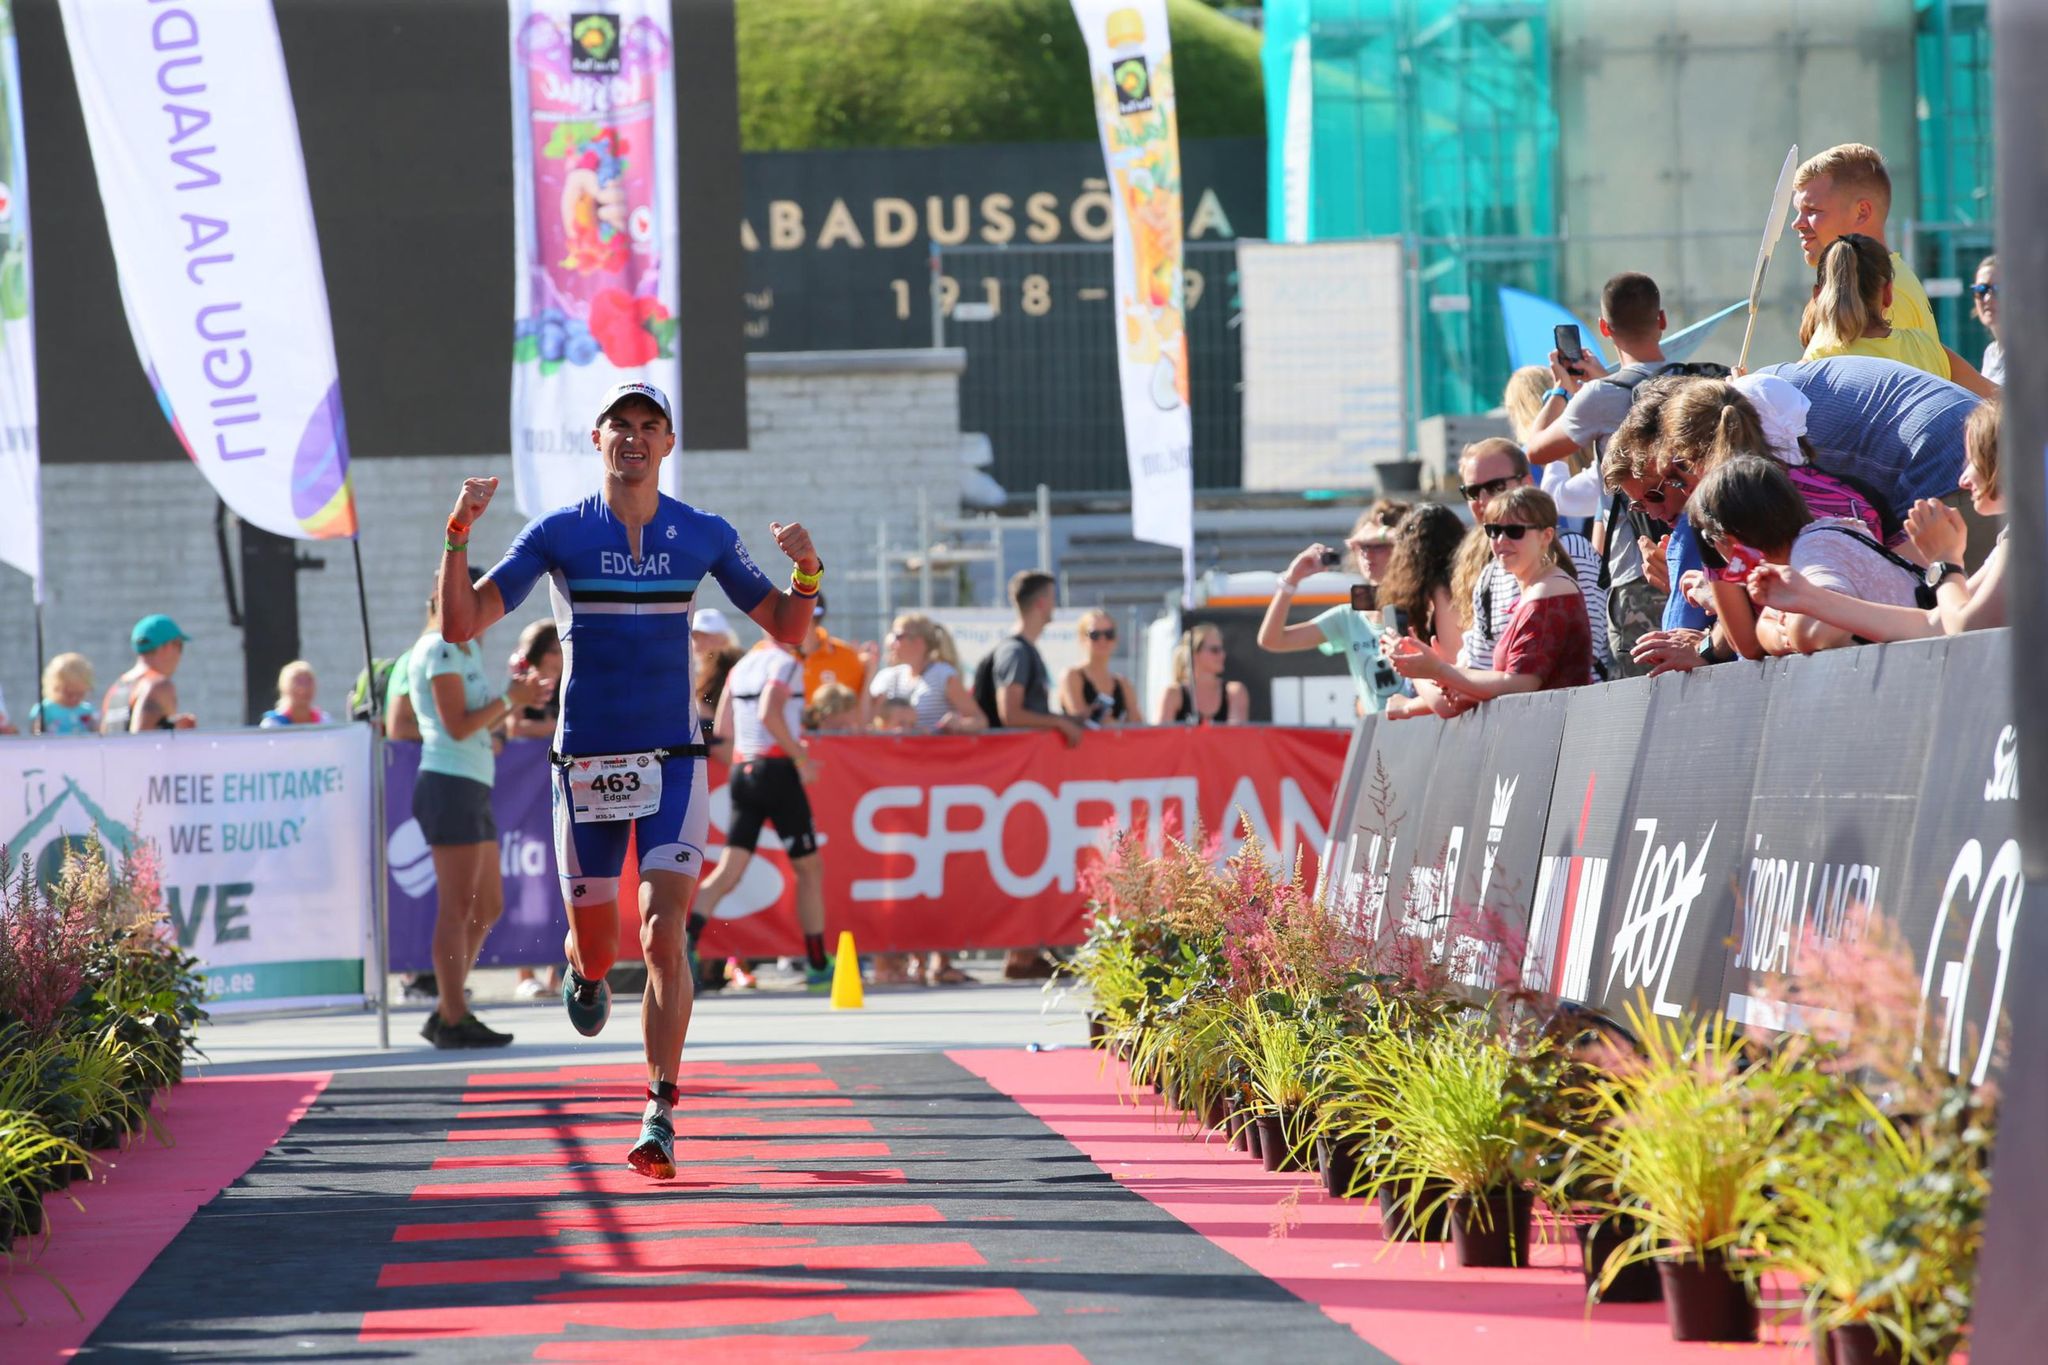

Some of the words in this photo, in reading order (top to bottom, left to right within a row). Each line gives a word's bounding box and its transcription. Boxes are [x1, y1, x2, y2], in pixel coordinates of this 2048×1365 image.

[601, 551, 671, 576] EDGAR
[148, 775, 214, 805] MEIE
[591, 771, 641, 793] 463
[603, 793, 631, 802] Edgar
[171, 824, 214, 854] WE
